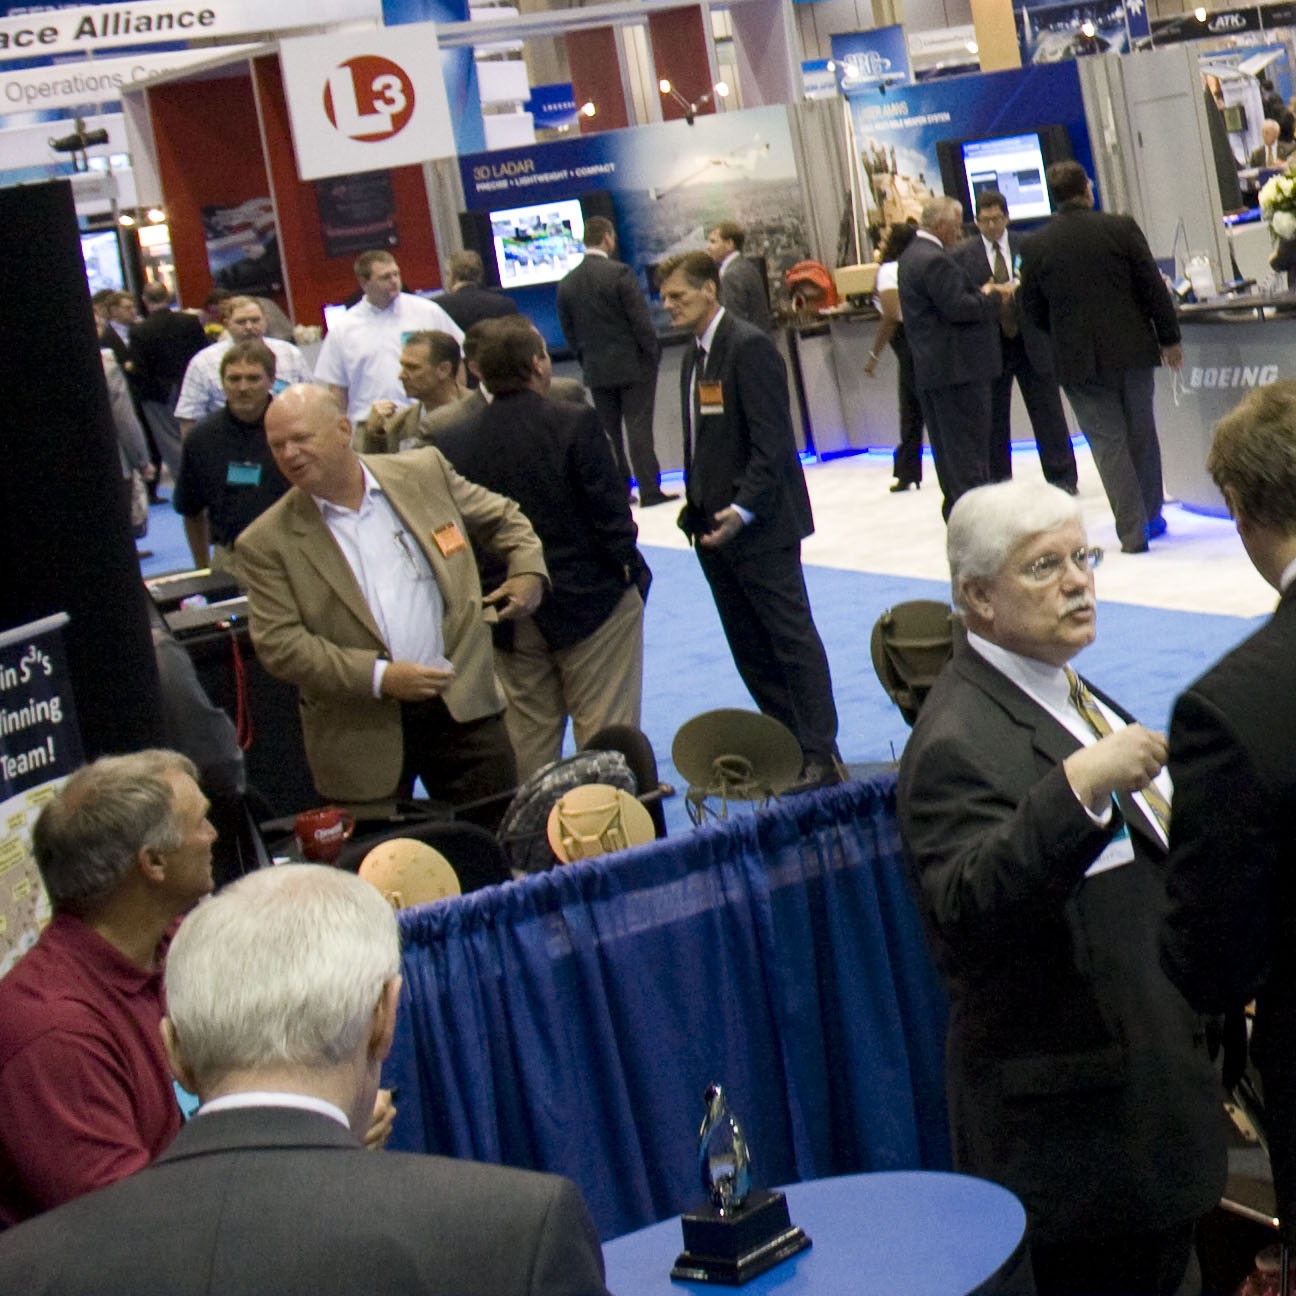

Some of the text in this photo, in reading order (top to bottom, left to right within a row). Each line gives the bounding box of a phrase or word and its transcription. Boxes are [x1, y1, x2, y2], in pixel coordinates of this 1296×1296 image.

[74, 8, 216, 40] Alliance
[1213, 13, 1241, 29] ATK
[4, 69, 124, 104] Operations
[491, 158, 535, 179] LADAR
[574, 162, 616, 179] COMPACT
[1189, 364, 1279, 388] BOEING
[0, 694, 63, 738] inning
